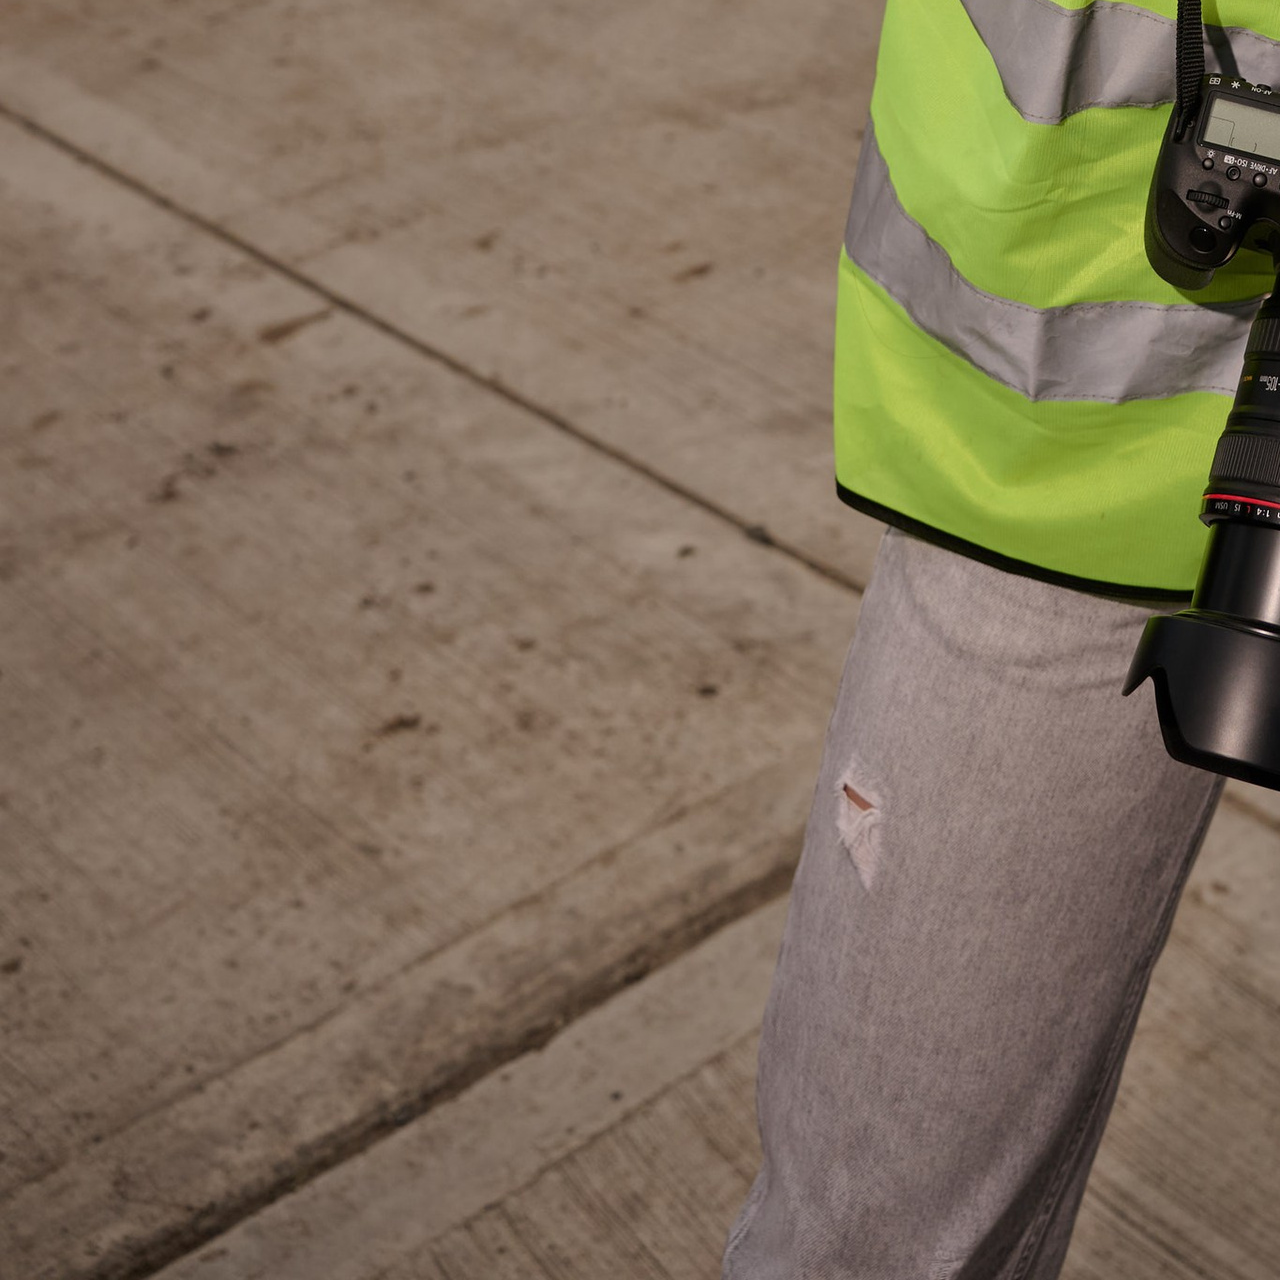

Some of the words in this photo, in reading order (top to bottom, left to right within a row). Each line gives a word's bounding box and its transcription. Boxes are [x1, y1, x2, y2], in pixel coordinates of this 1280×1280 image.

[1215, 501, 1229, 510] USM
[1234, 503, 1241, 512] IS
[1256, 508, 1270, 518] 1:4
